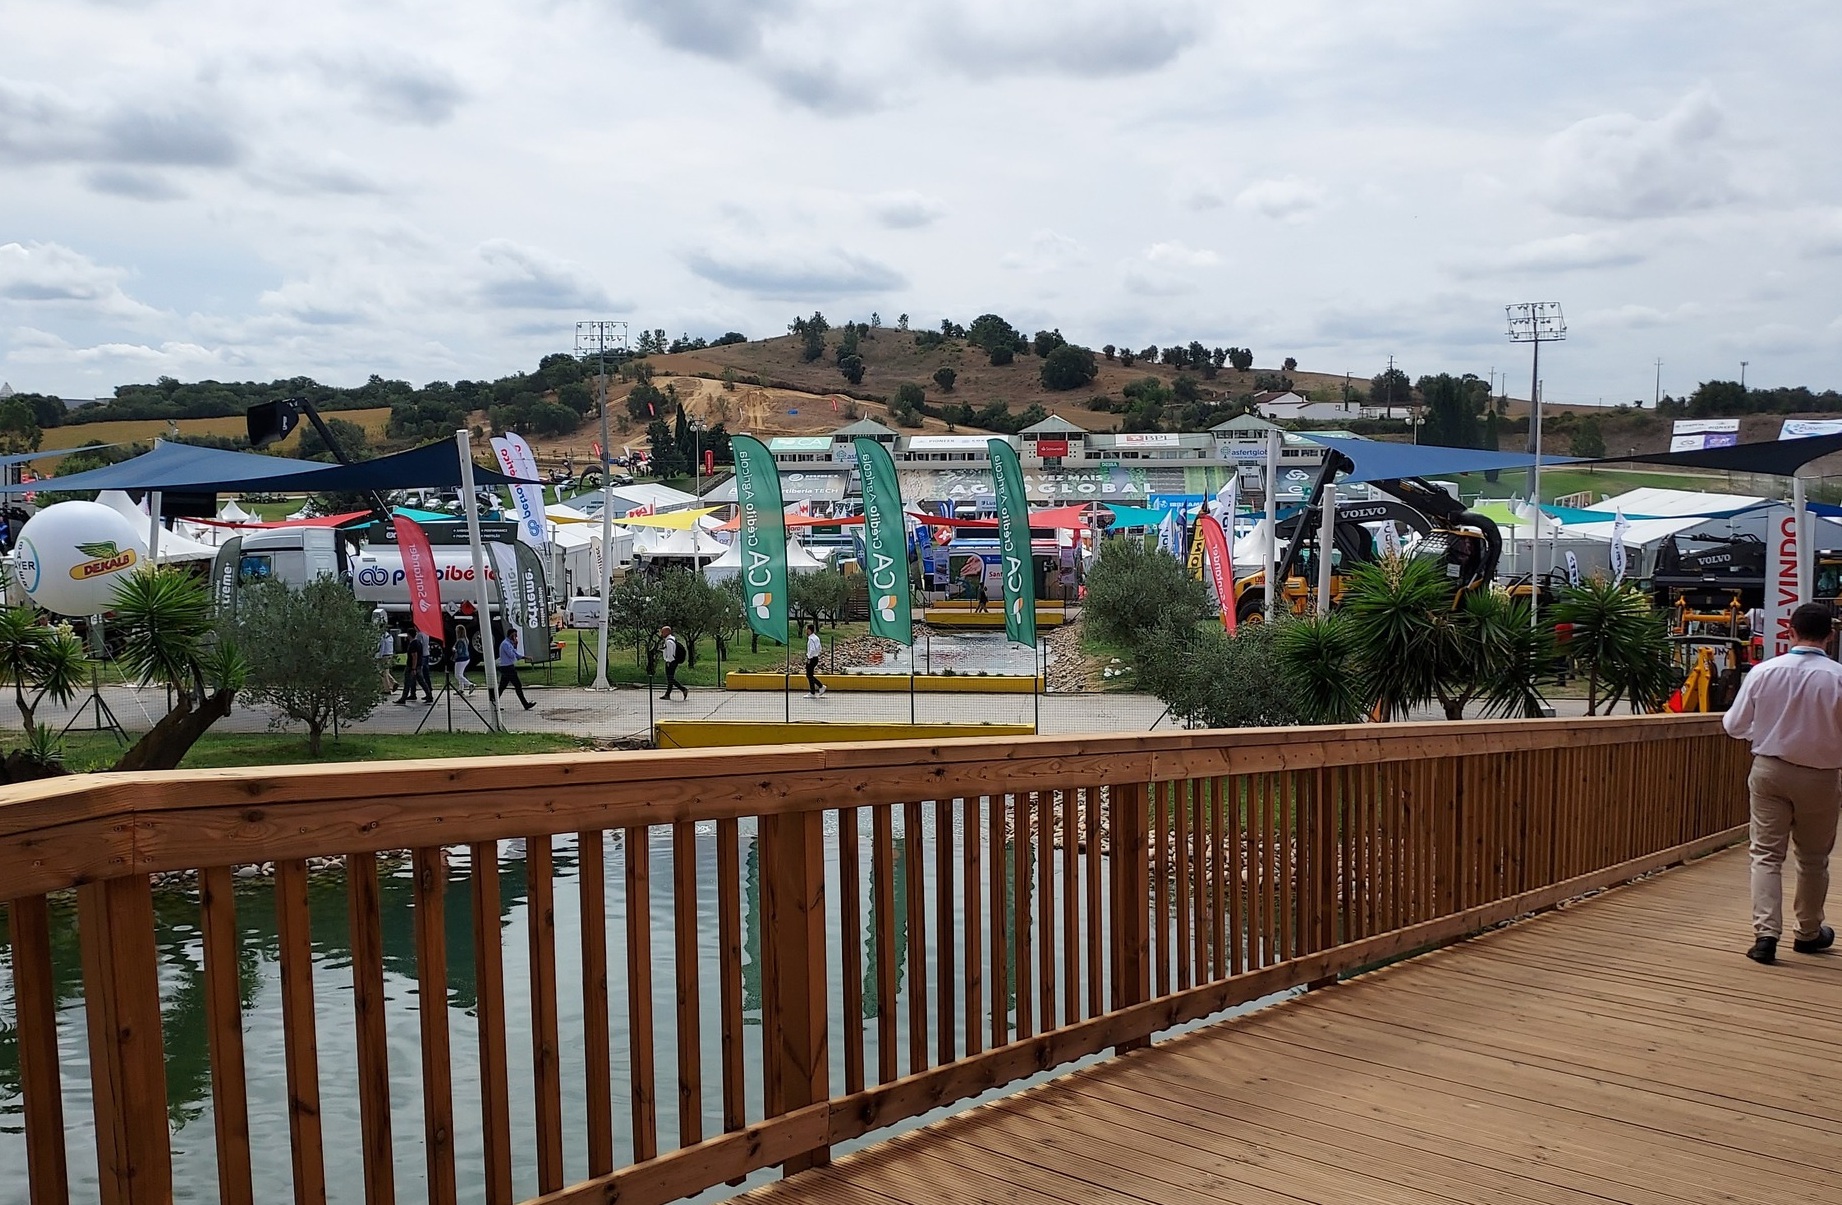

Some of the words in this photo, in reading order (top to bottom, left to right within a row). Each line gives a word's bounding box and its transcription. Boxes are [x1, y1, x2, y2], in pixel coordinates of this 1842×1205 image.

[1340, 506, 1387, 519] VOLVO
[15, 561, 36, 571] AYER
[83, 554, 130, 576] DEKALB
[1698, 553, 1731, 566] VOLVO
[1775, 516, 1798, 657] EM-VINDO
